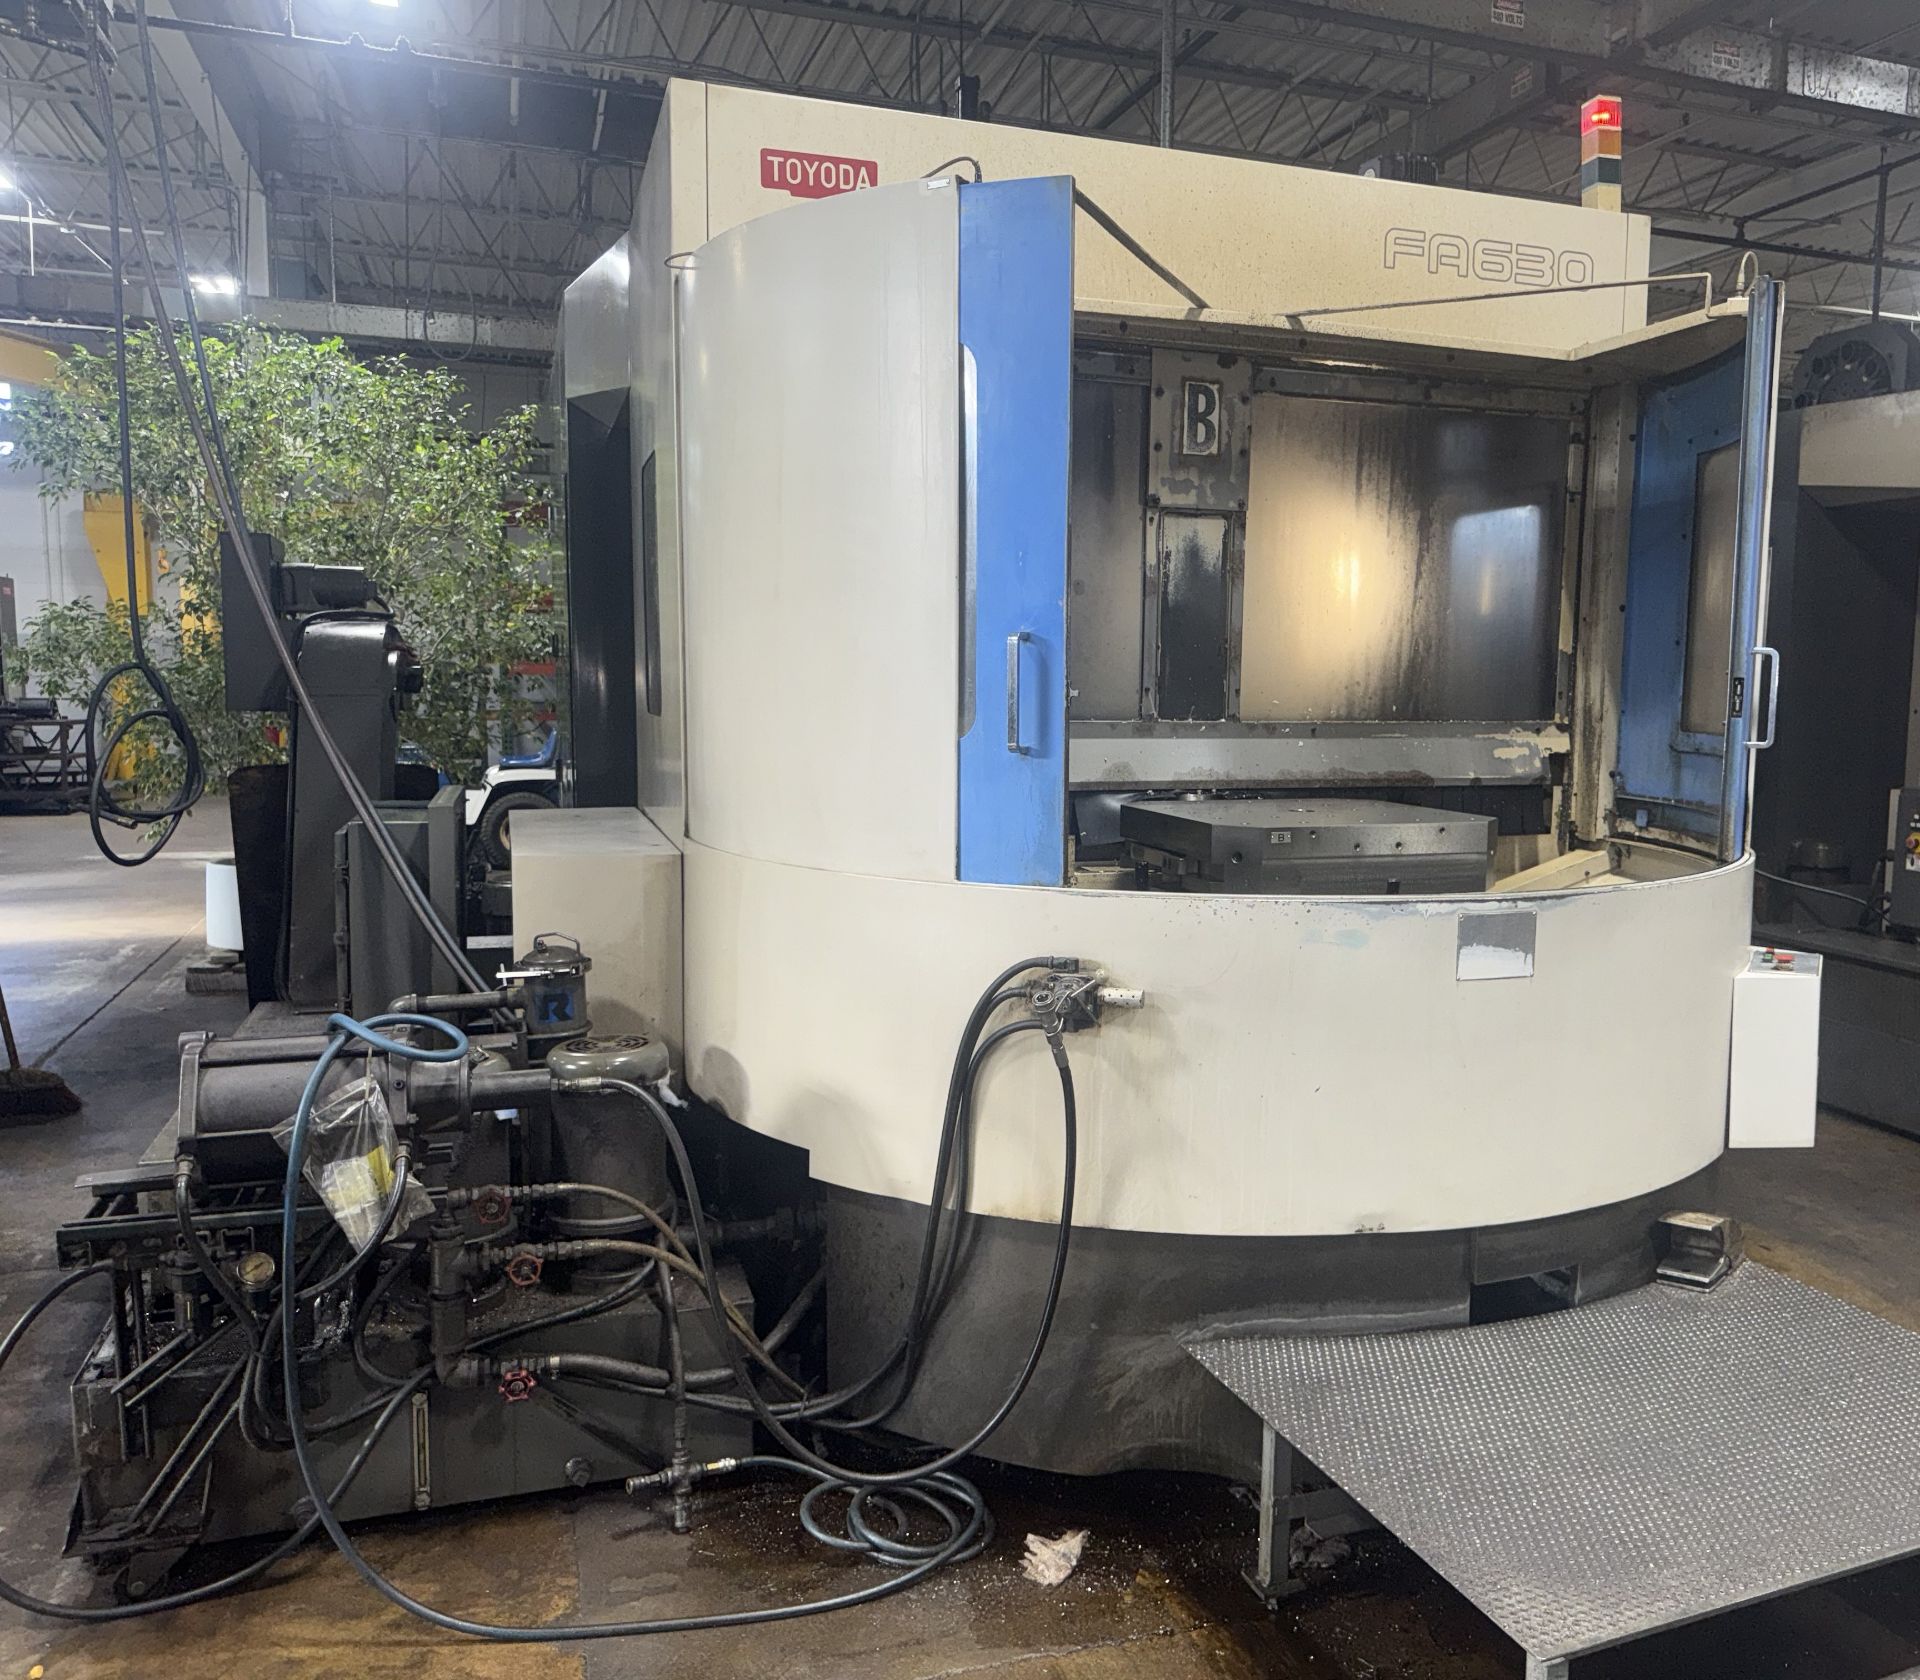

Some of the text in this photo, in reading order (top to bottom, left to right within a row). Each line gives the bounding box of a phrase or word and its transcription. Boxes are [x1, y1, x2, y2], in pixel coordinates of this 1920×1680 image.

[766, 155, 871, 191] TOYODA
[1383, 227, 1595, 292] FA630
[1186, 382, 1217, 453] B
[539, 993, 574, 1021] R
